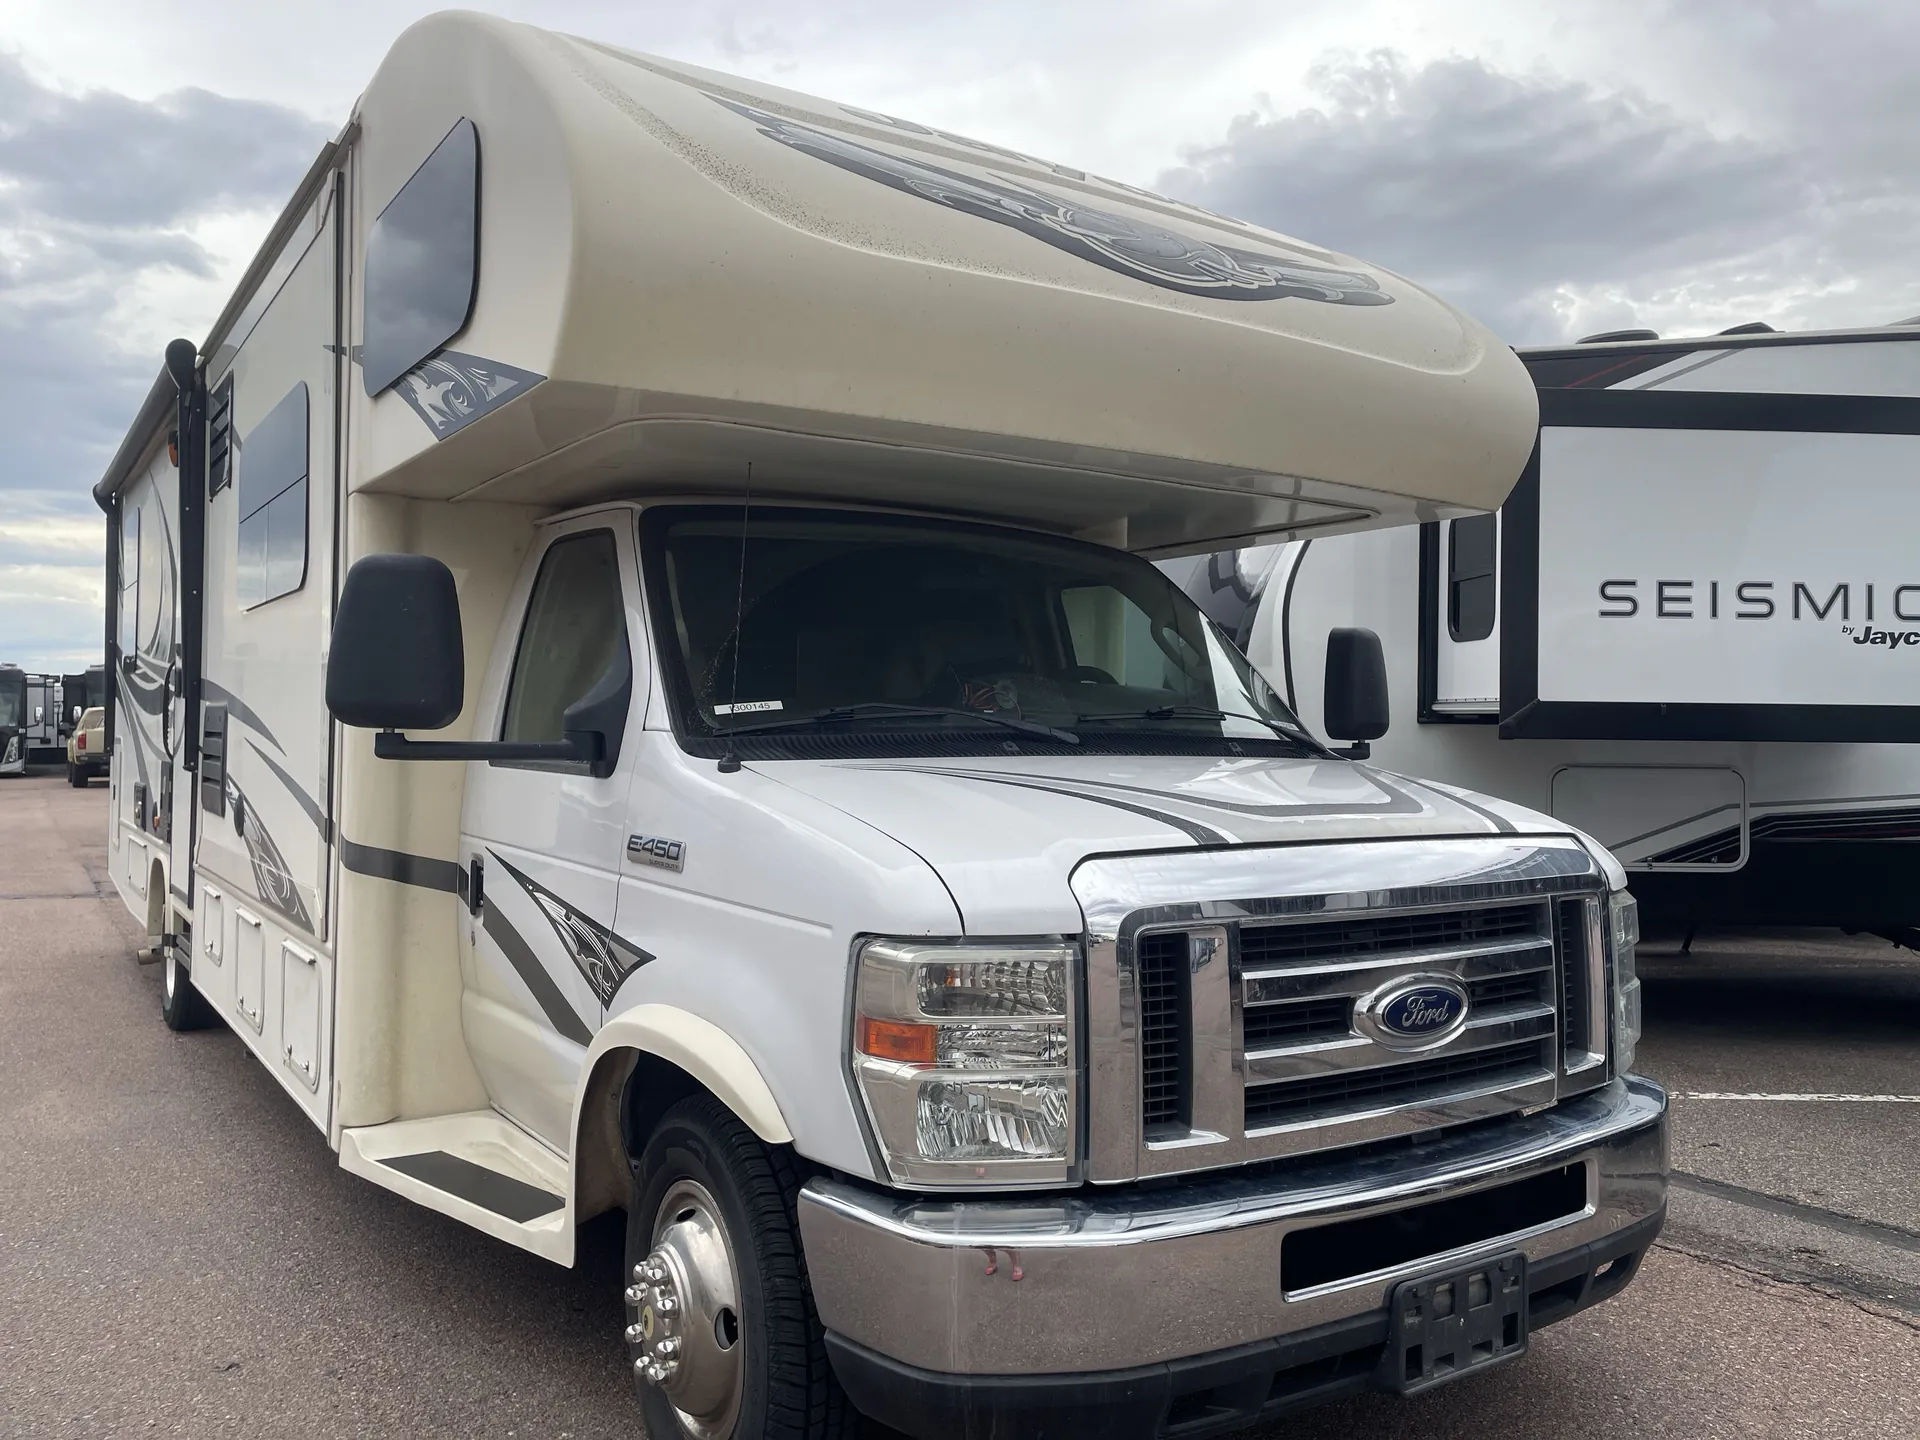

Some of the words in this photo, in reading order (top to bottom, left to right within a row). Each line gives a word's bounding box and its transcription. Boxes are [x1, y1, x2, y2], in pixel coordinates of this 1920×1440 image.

[1598, 579, 1920, 622] SEISMIC
[1841, 625, 1855, 635] by
[1402, 994, 1450, 1028] Ford
